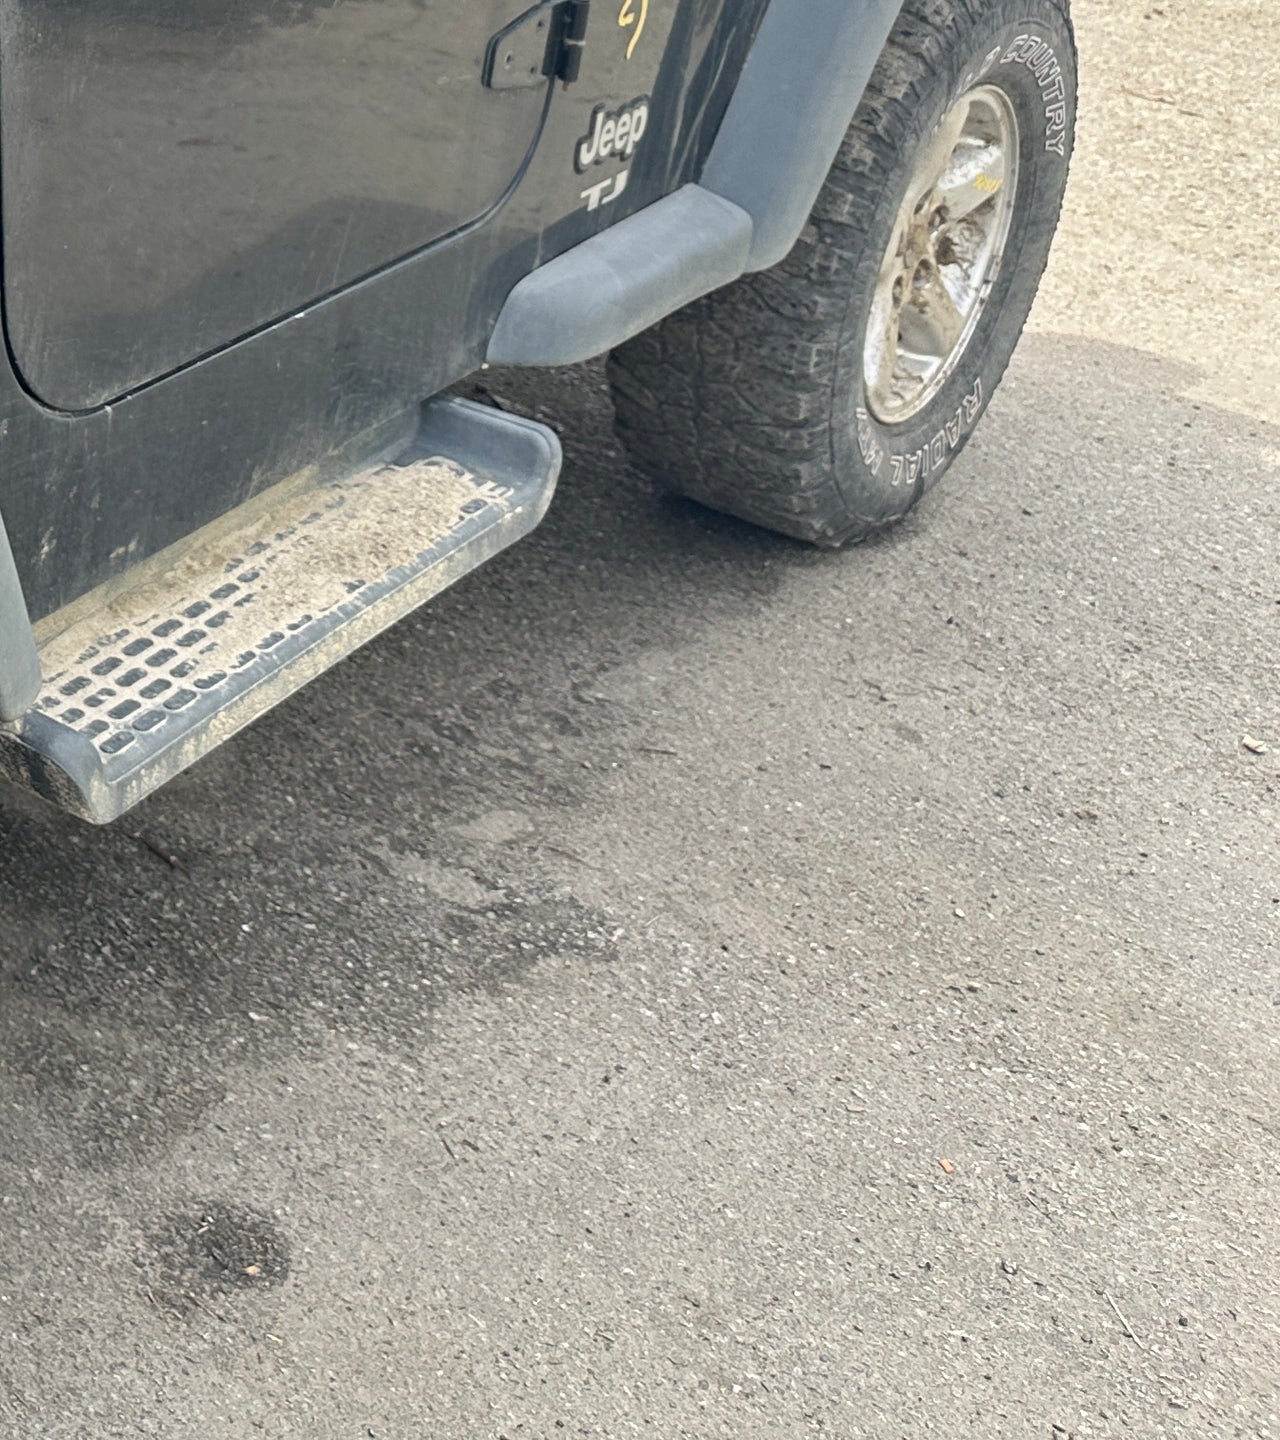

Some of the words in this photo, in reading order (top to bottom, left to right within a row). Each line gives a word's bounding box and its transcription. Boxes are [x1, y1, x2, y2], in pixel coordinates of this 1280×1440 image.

[580, 105, 648, 164] Jeep
[999, 33, 1067, 157] COUNTRY
[580, 169, 629, 212] TJ
[889, 377, 982, 486] RADIAL
